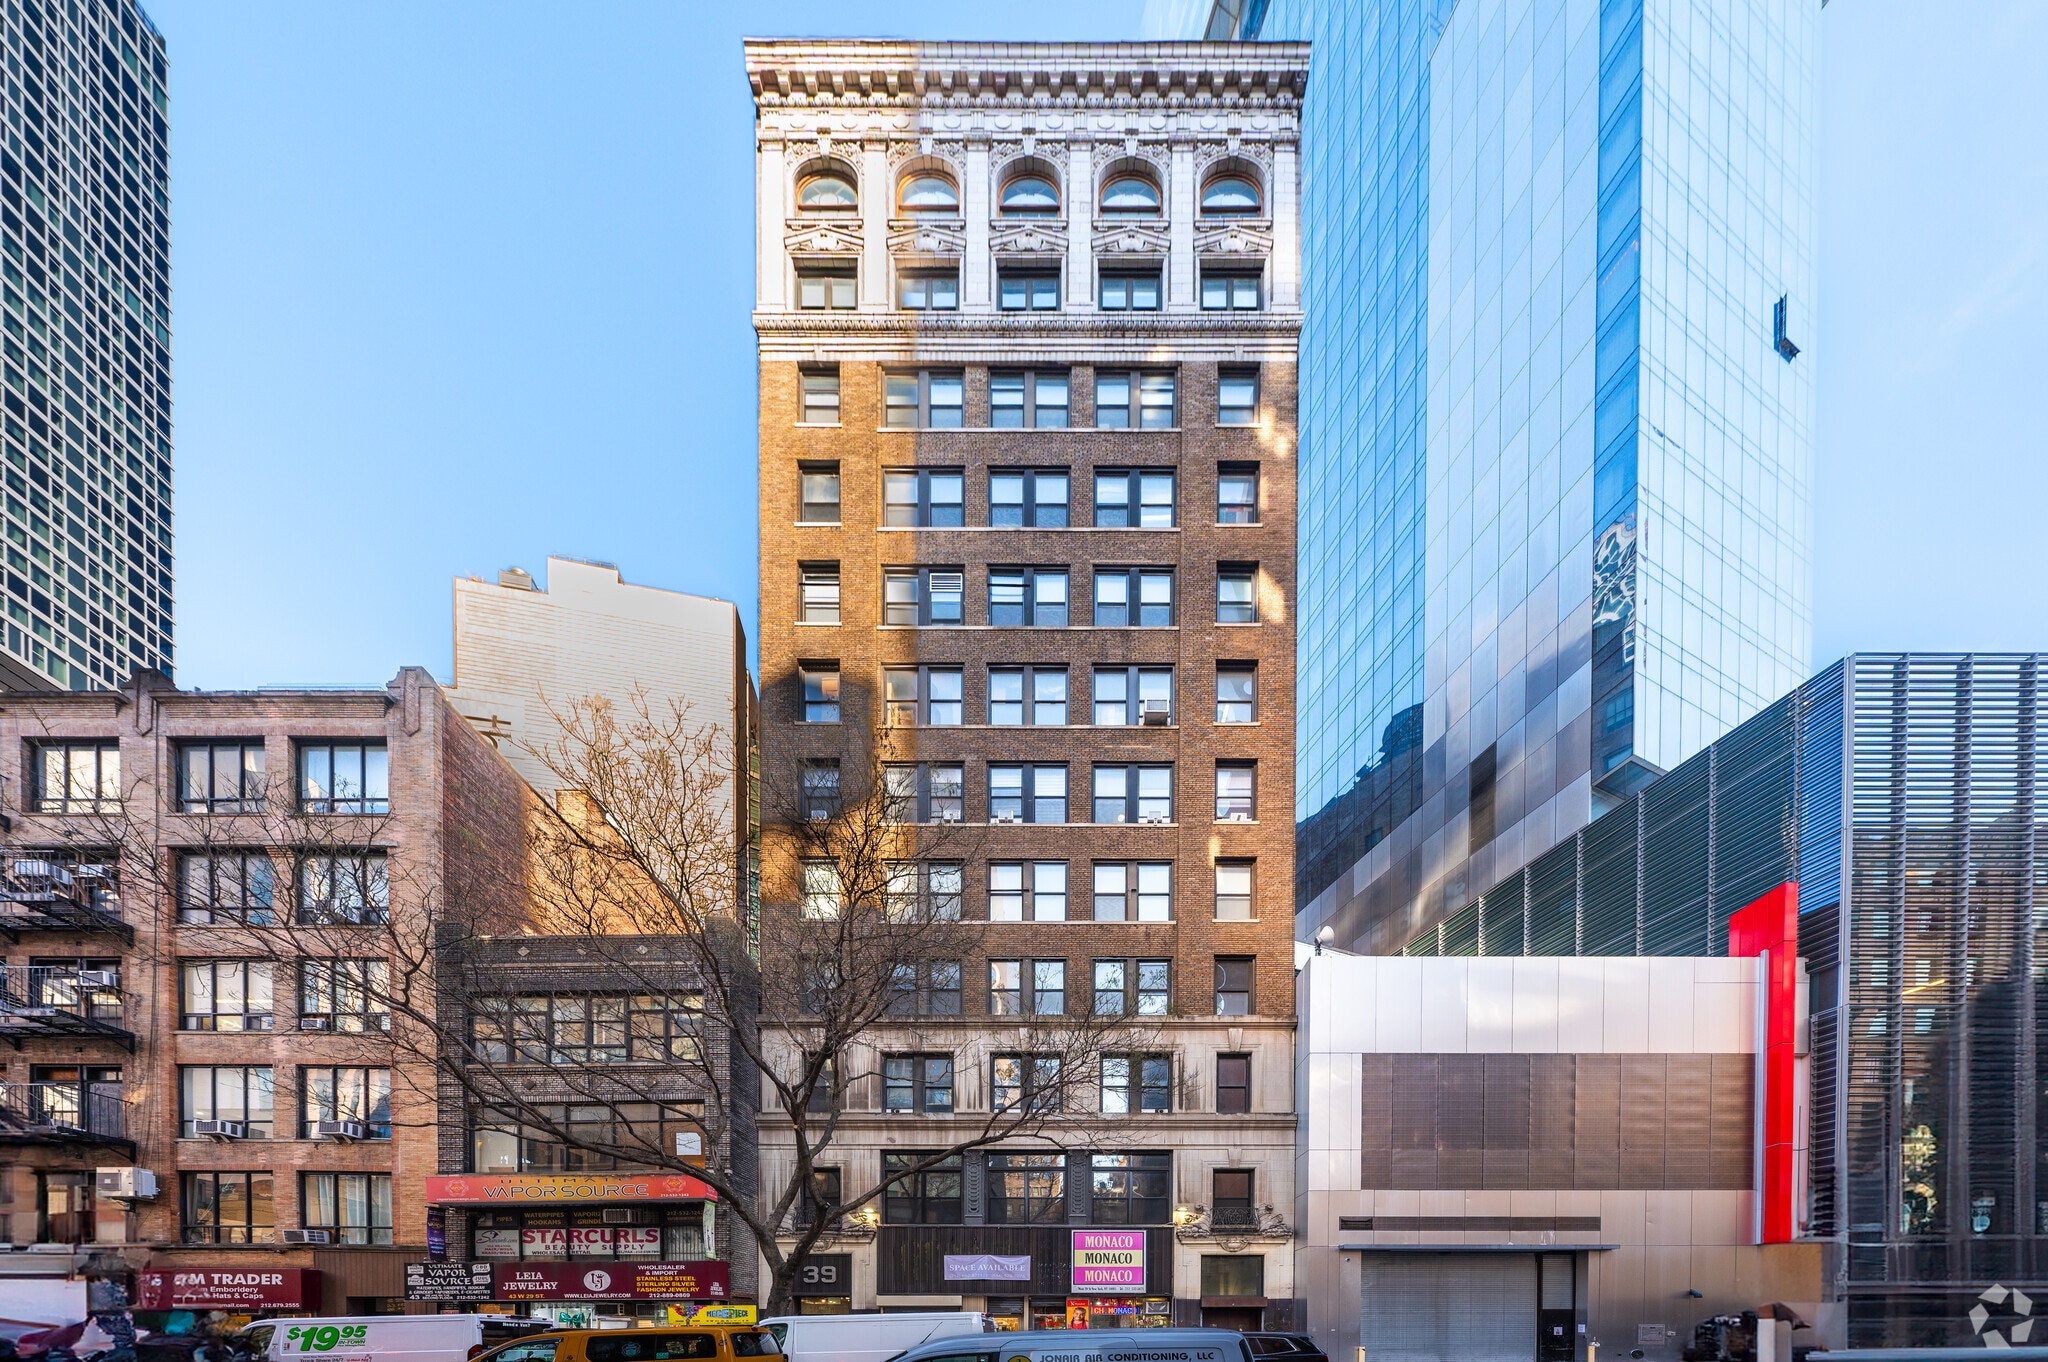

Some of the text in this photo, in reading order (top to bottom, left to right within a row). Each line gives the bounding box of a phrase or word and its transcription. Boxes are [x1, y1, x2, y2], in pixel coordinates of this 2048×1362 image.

[483, 1183, 649, 1199] VAPOR SOURCE
[522, 1229, 659, 1244] STARCURLS
[1084, 1236, 1133, 1248] MONACO
[1084, 1252, 1132, 1264] MONACO
[428, 1269, 467, 1277] VAPOR
[515, 1272, 543, 1280] LEIA
[803, 1265, 837, 1283] 39
[1084, 1270, 1132, 1282] MONACO
[211, 1273, 283, 1285] TRADER
[425, 1277, 472, 1285] SOURCE
[210, 1286, 258, 1294] Emboridery
[502, 1281, 558, 1291] JEWELRY
[242, 1292, 264, 1300] Caps
[1039, 1354, 1080, 1362] JONAIR
[1085, 1353, 1102, 1362] AIR
[1107, 1352, 1192, 1361] CONDITIONING,
